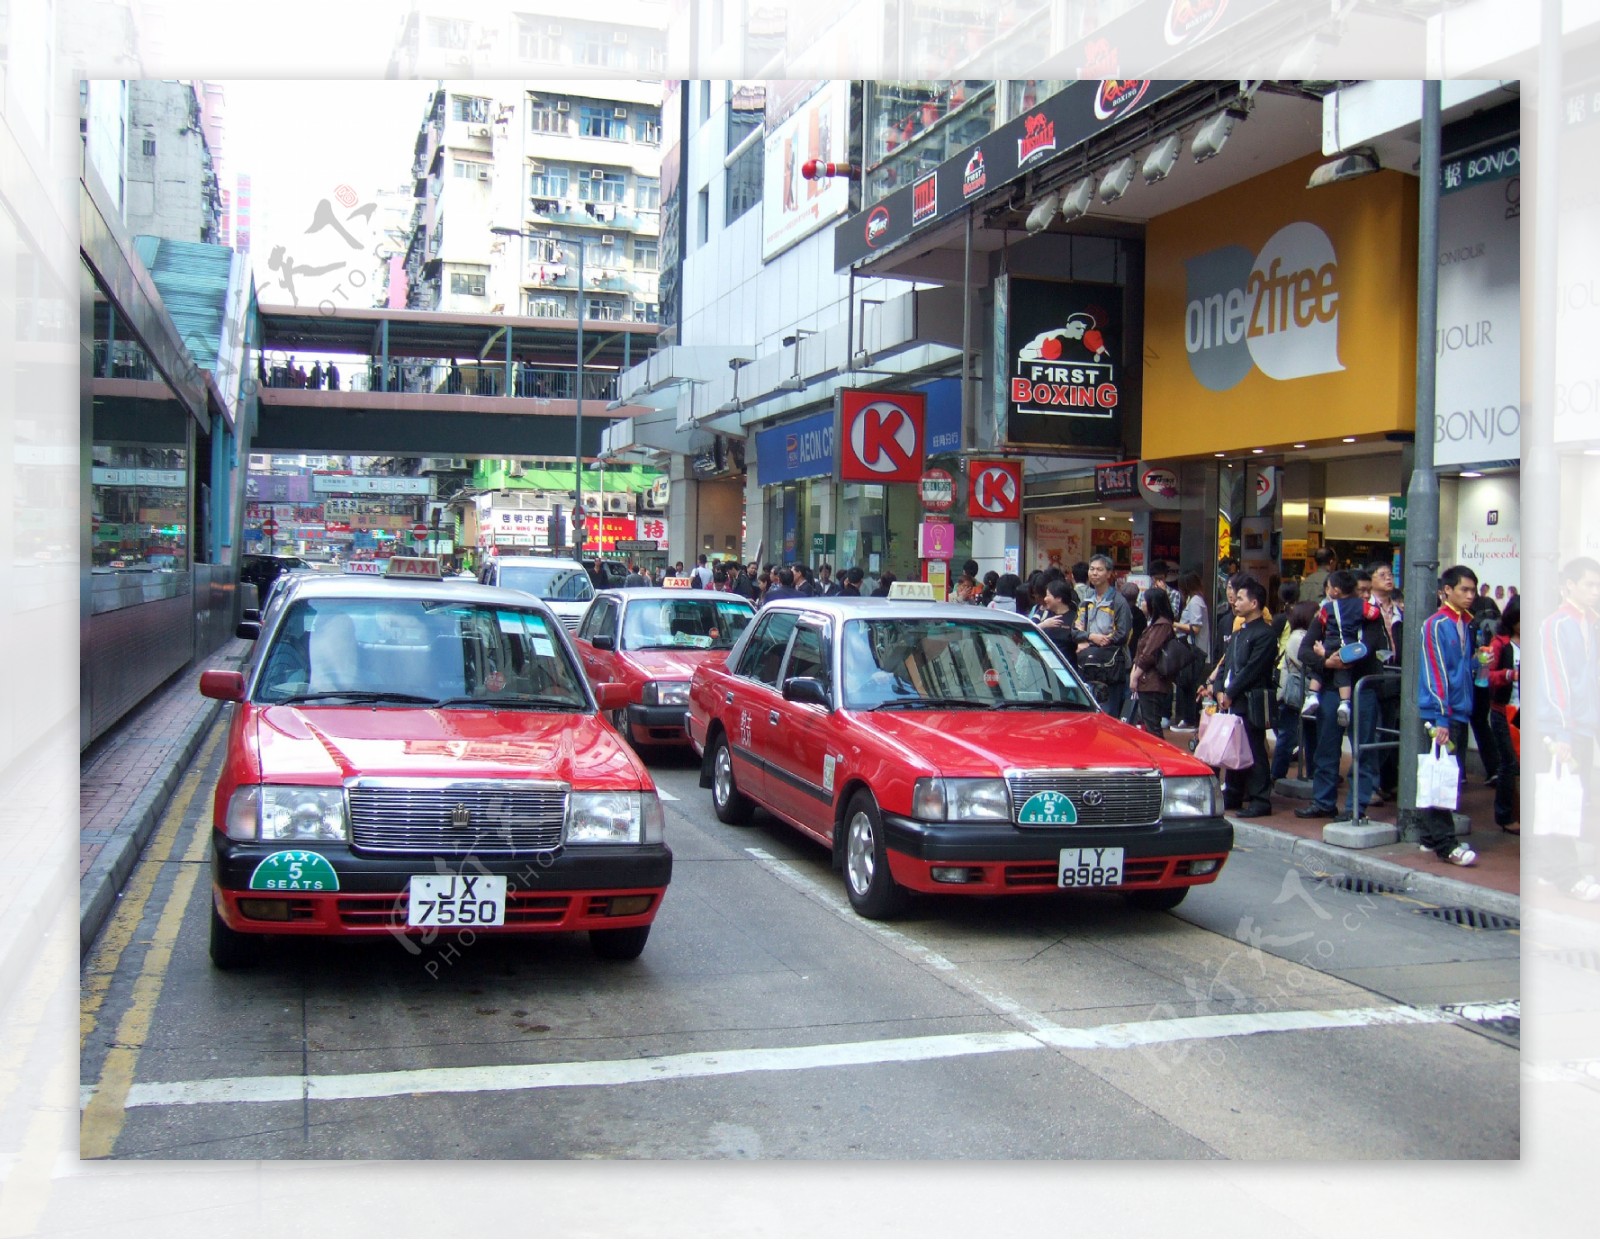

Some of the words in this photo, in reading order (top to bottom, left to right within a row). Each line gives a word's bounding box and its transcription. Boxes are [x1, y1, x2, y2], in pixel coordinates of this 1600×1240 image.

[1112, 88, 1137, 107] BOXING
[1467, 146, 1520, 179] BONJO
[1438, 243, 1486, 266] ONJOUR
[1185, 257, 1340, 355] one2free
[1436, 320, 1493, 358] JOUR
[1011, 377, 1118, 408] BOXING
[800, 430, 822, 463] AEON
[863, 407, 913, 467] K
[932, 431, 959, 448] 旺角分行
[982, 470, 1014, 512] K
[350, 563, 377, 572] TAXI
[395, 559, 436, 575] TAXI
[667, 578, 690, 587] TAXI
[898, 584, 932, 597] TAXI
[1037, 793, 1063, 803] TAXI
[1044, 801, 1055, 813] 5
[1029, 813, 1067, 822] SEATS
[268, 852, 320, 867] TAXI
[1077, 848, 1105, 868] LY
[288, 862, 303, 880] 5
[1062, 867, 1119, 886] 8982
[266, 879, 324, 890] SEATS
[437, 876, 479, 900] JX
[417, 900, 497, 924] 7550
